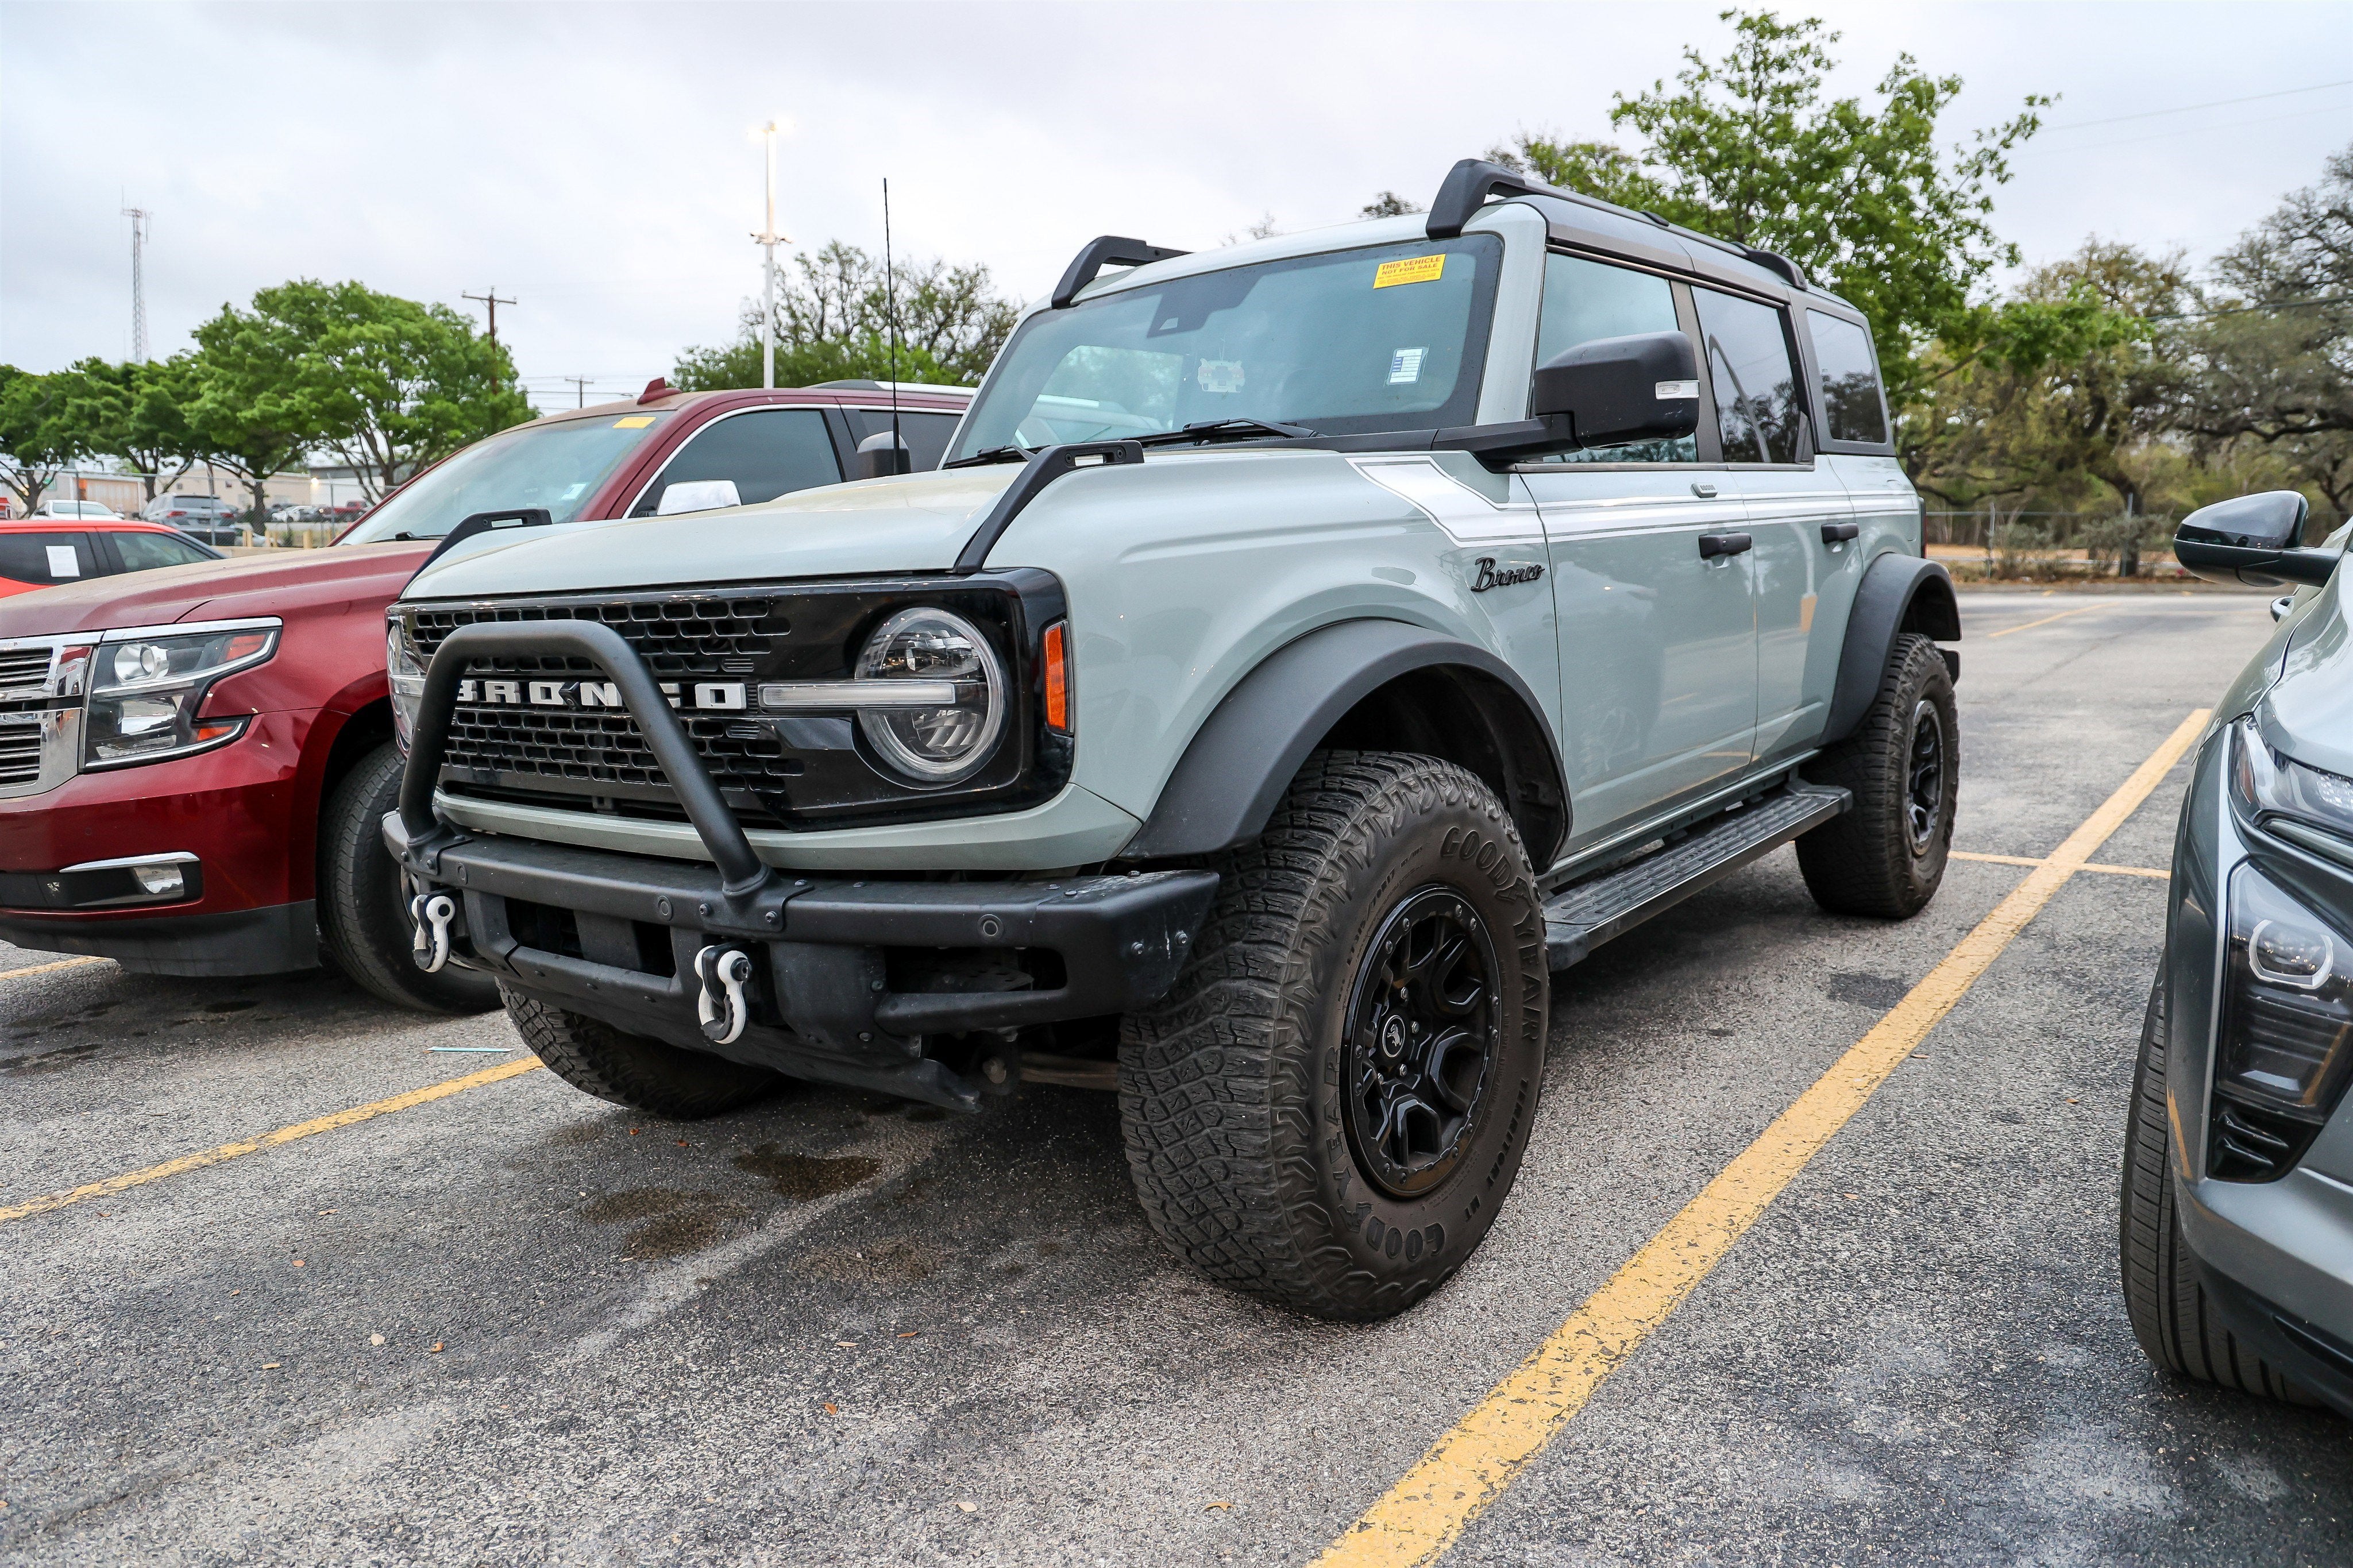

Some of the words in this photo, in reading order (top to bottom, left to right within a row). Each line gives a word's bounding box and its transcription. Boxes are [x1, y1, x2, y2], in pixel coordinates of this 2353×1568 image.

[1382, 262, 1401, 270] THIS
[1404, 256, 1441, 267] VEHICLE
[1471, 557, 1545, 592] Bronco
